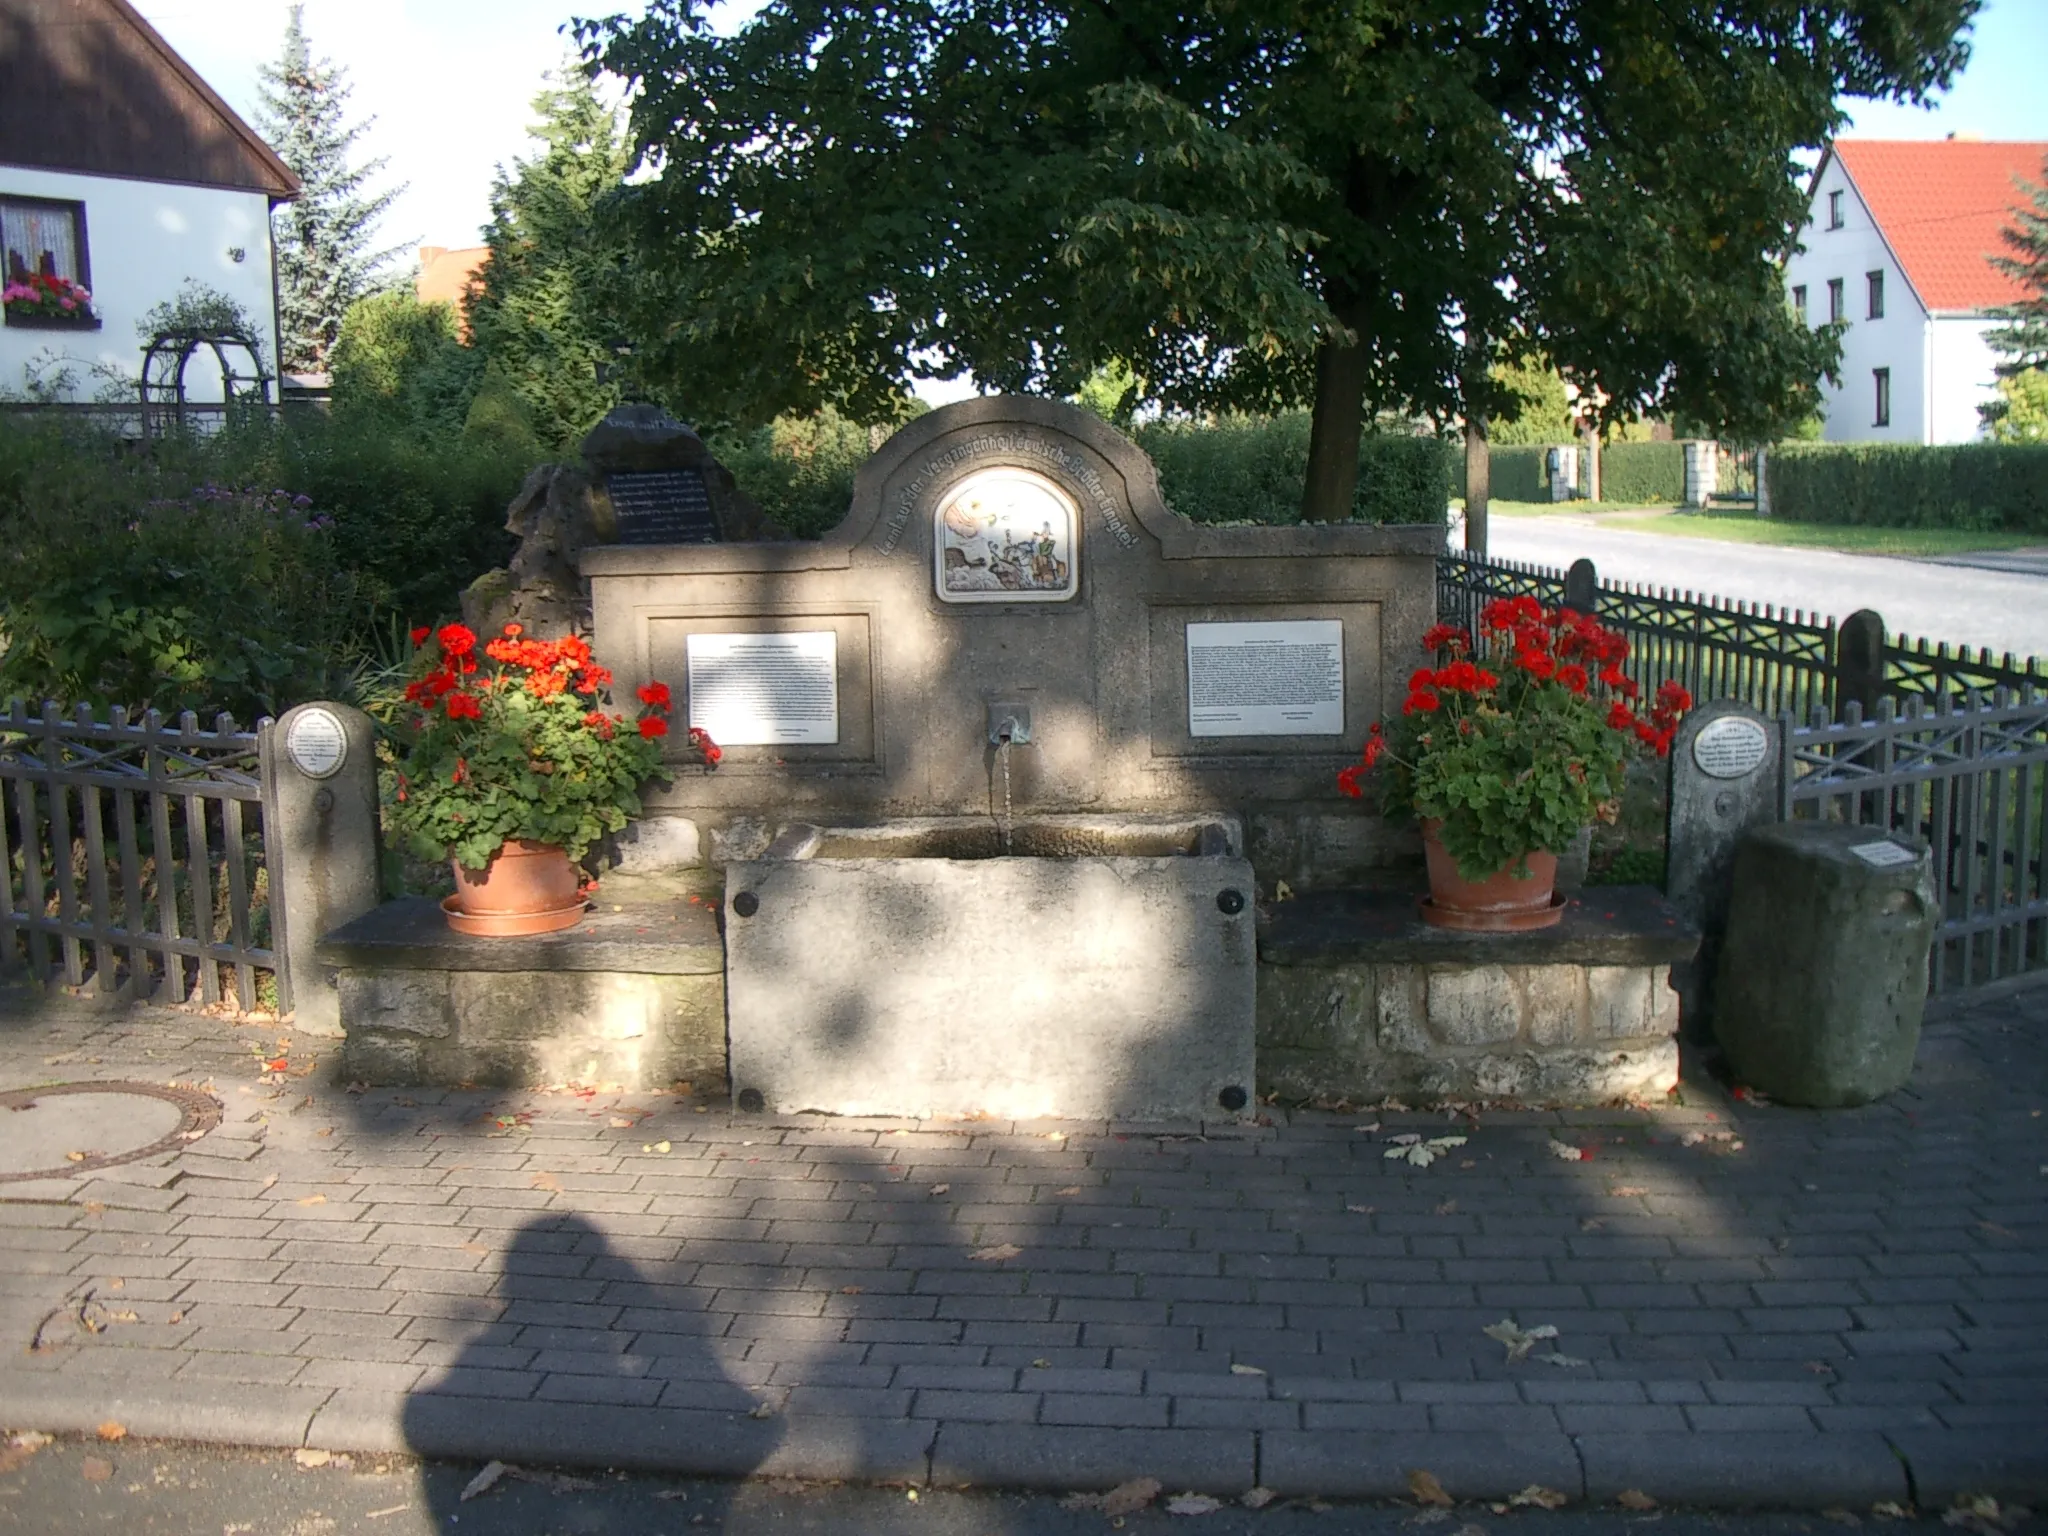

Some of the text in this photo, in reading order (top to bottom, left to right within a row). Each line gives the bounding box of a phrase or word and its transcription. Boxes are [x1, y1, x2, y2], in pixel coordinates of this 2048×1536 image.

[900, 476, 925, 500] der
[1068, 455, 1105, 498] Brüder
[895, 499, 914, 523] aus
